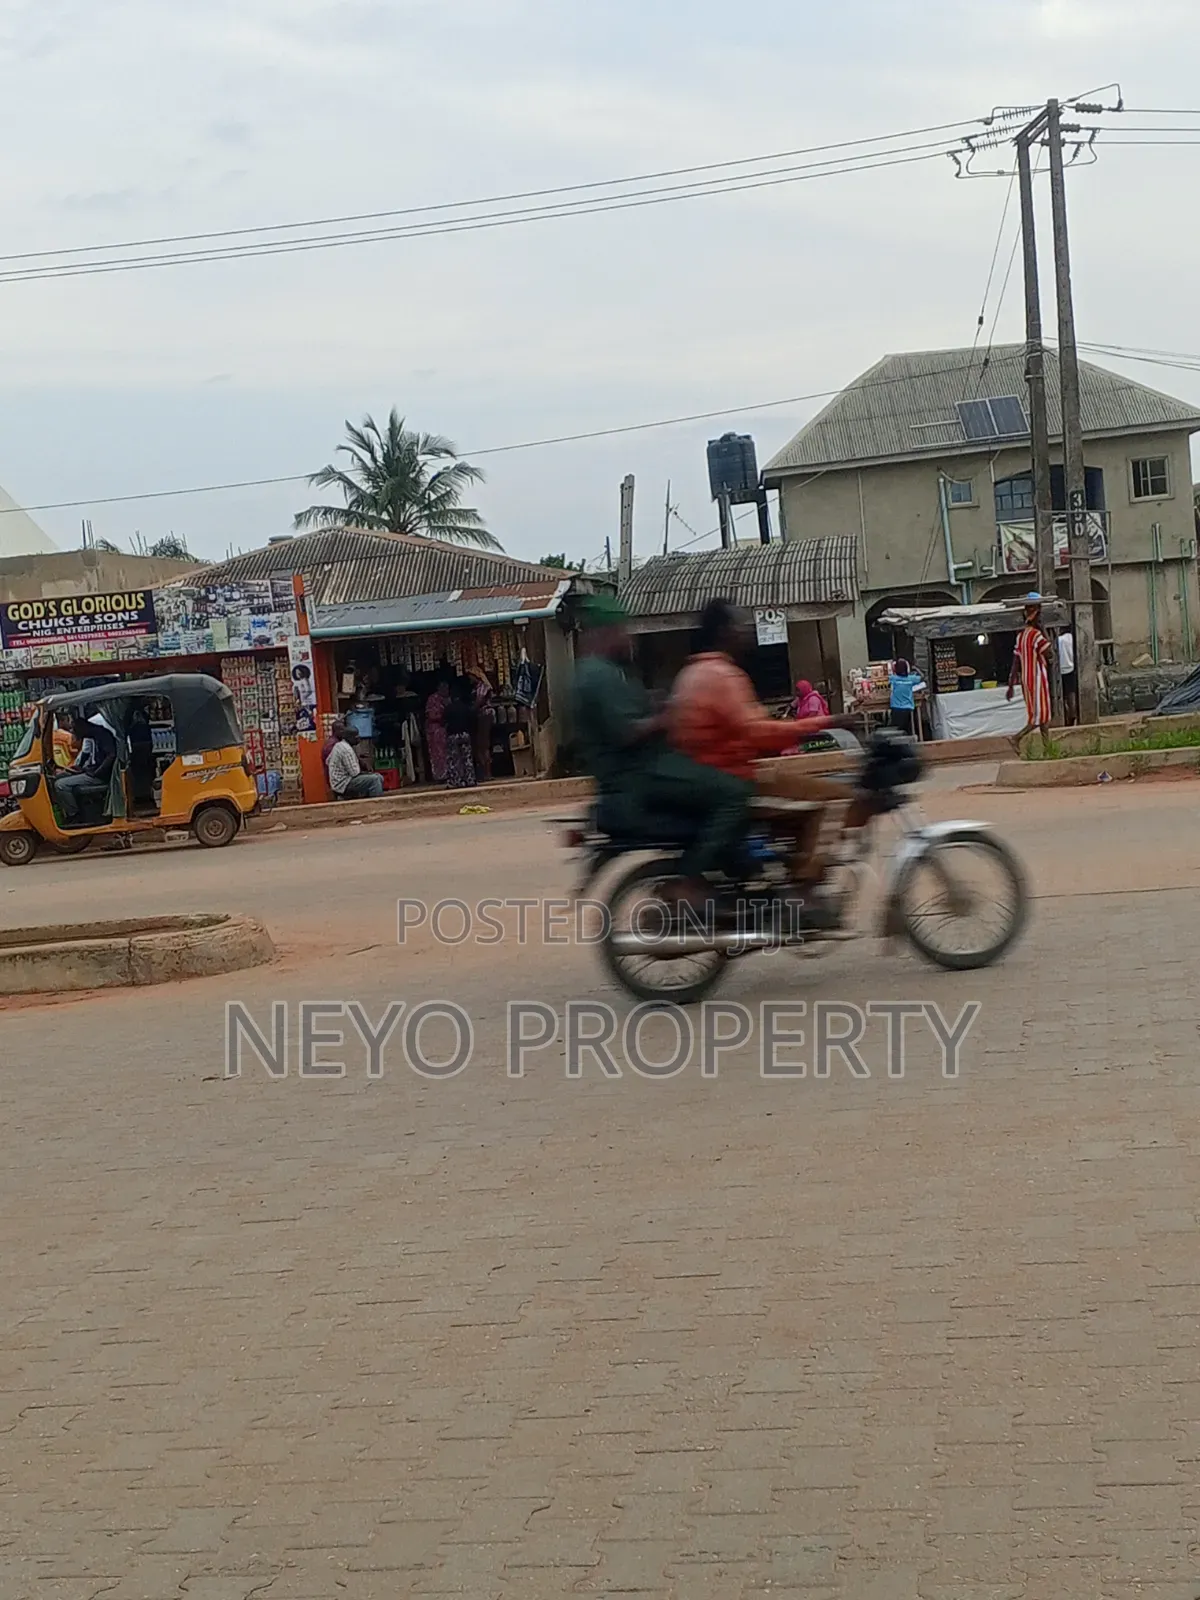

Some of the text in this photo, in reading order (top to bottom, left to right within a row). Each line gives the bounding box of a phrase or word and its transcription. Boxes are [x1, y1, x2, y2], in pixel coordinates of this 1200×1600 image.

[7, 592, 146, 621] GOD'S GLORIOUS
[755, 607, 786, 623] POS
[17, 610, 139, 630] CHUKS & SONS
[56, 621, 125, 635] ENTERPRISES
